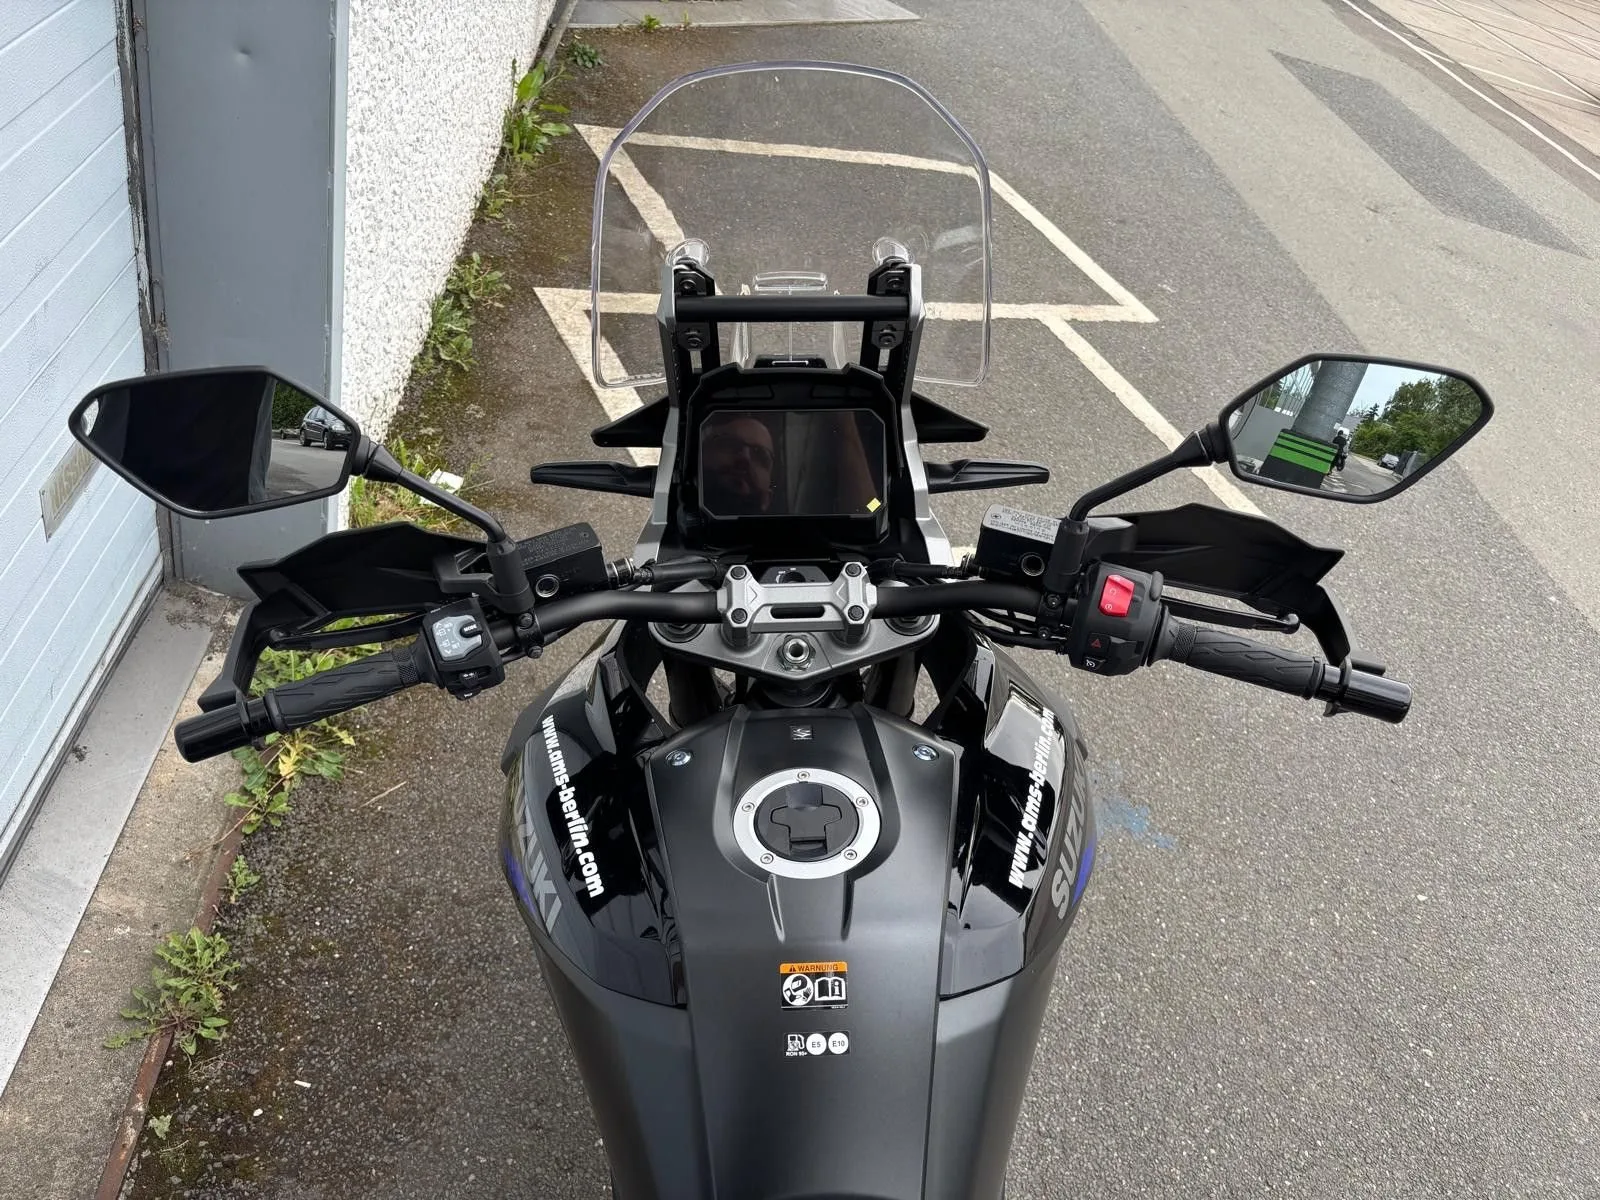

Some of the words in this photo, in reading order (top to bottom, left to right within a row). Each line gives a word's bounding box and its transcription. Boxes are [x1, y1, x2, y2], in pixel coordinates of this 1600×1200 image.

[541, 714, 605, 898] www.ams-berlin.com
[1008, 706, 1056, 889] www.ams-berlin.com
[797, 964, 839, 972] WARNUNG
[832, 1040, 845, 1048] E10
